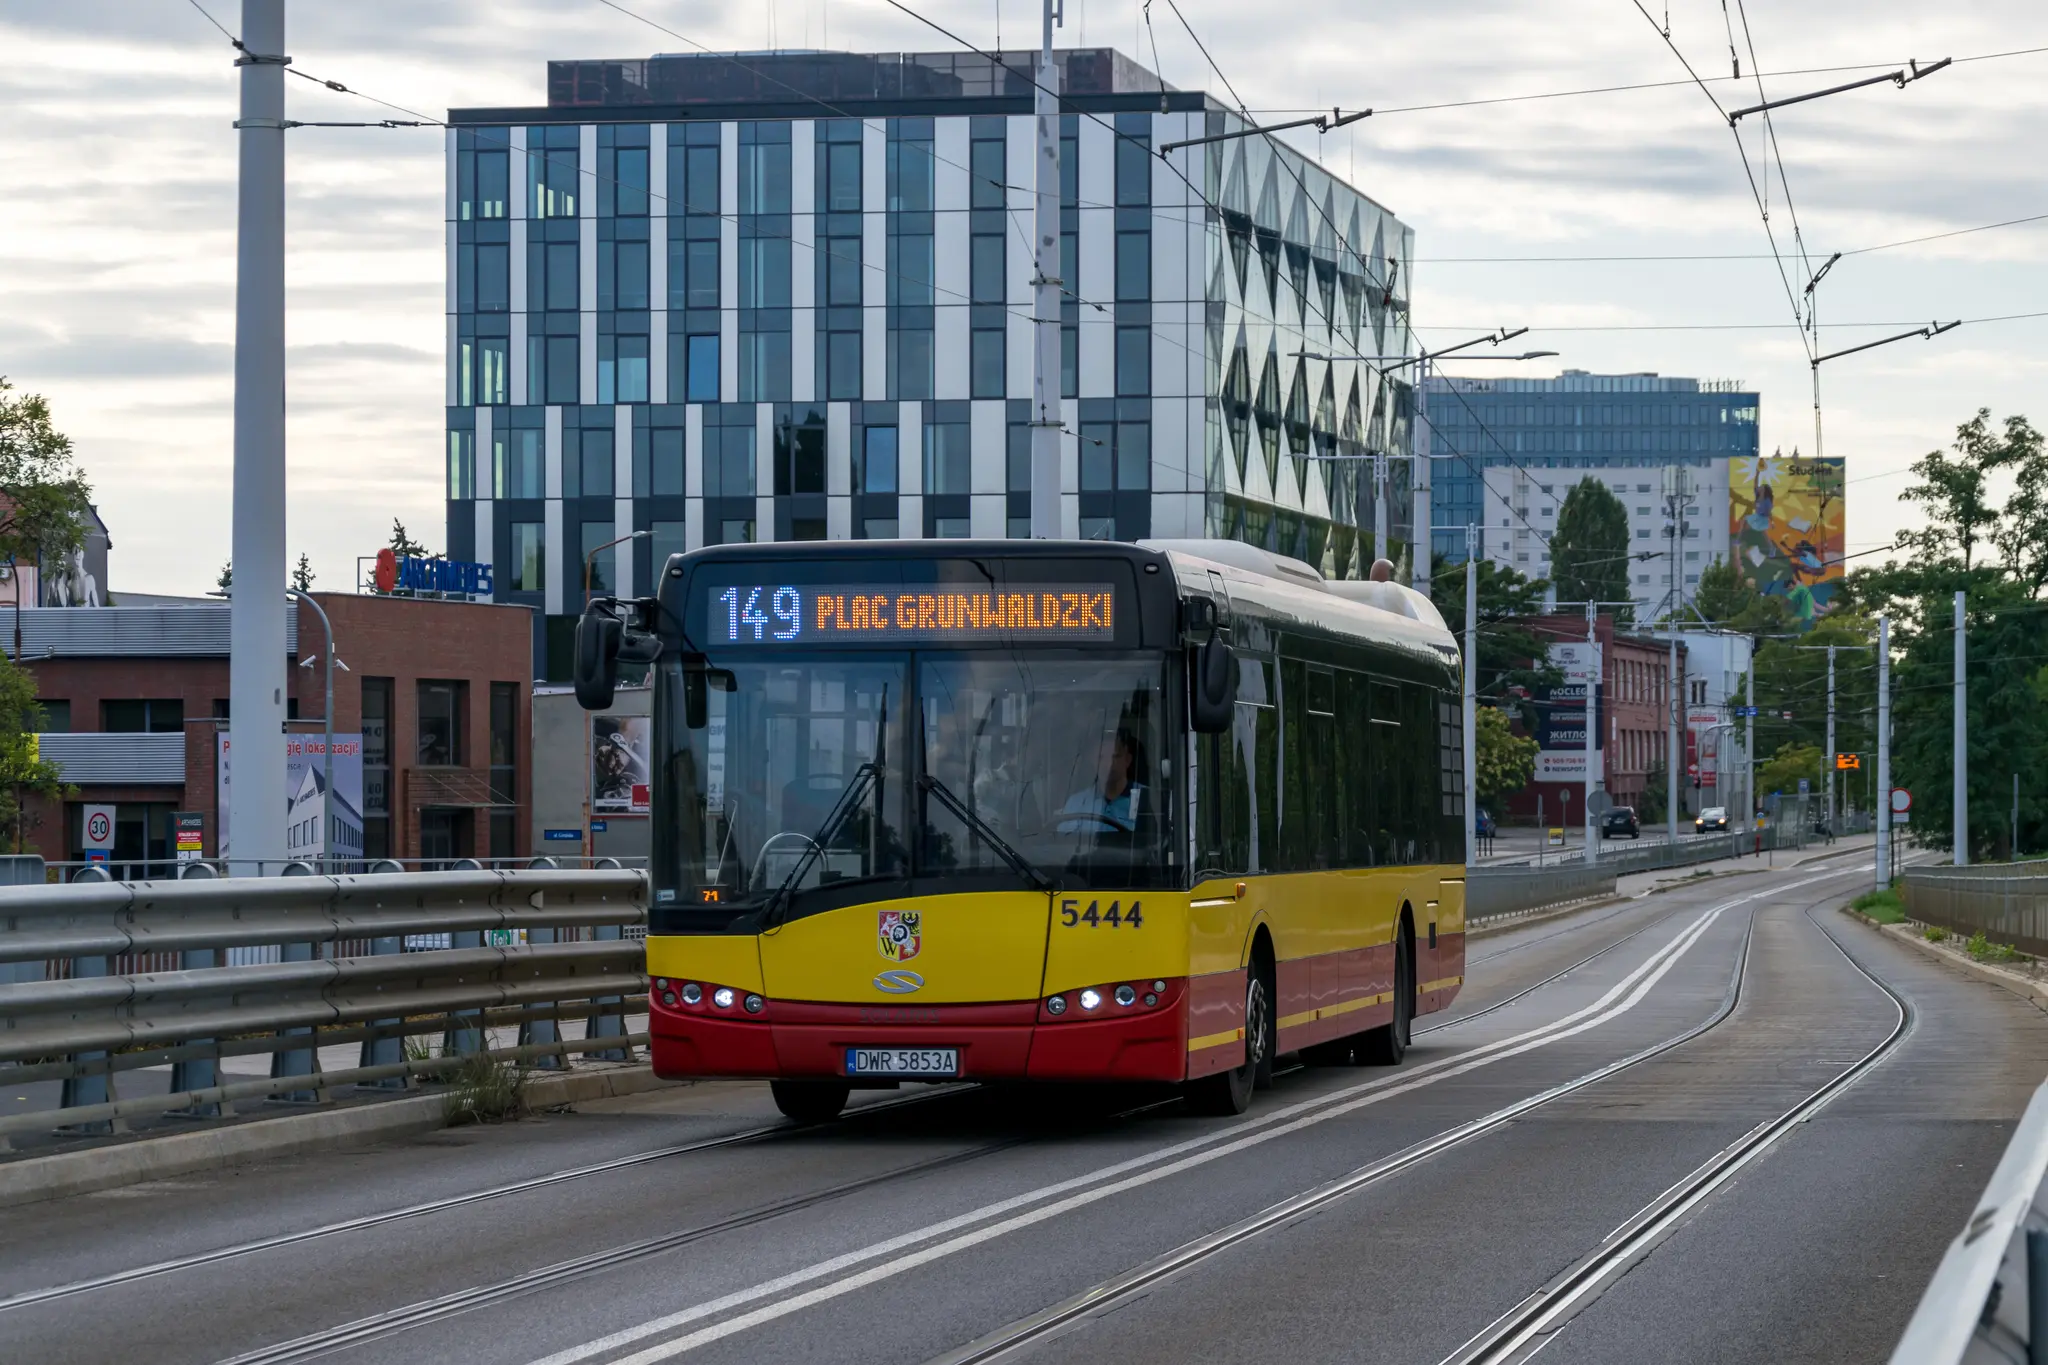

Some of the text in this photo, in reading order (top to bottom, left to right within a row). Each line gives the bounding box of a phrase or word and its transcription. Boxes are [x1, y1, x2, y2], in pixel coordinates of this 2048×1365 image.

[399, 554, 493, 595] ARCHIMEDES
[719, 586, 1112, 640] 149 PLAC GRUNWALDZKI
[92, 821, 107, 835] 30
[702, 889, 719, 902] 71
[1061, 899, 1144, 928] 5444
[859, 1009, 940, 1024] SOLARIS
[857, 1051, 955, 1071] DWR 5853A
